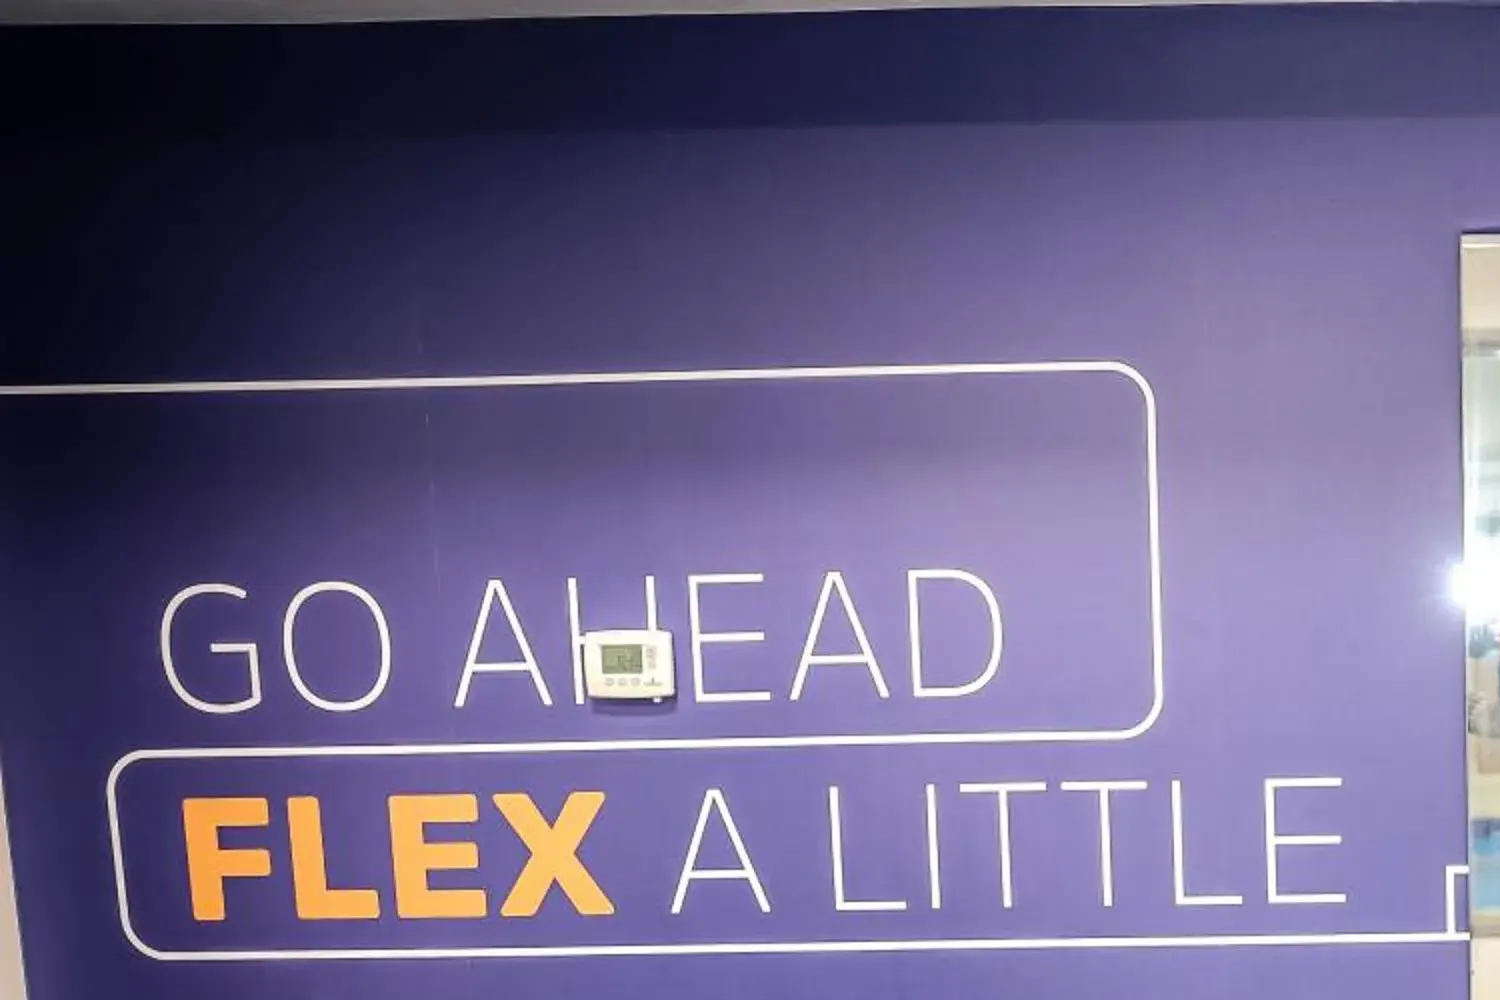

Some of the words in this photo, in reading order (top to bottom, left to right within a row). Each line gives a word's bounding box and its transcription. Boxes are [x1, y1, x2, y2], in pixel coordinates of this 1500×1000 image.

[160, 581, 392, 715] GO
[454, 568, 1004, 709] AHEAD
[182, 791, 616, 922] FLEX
[670, 787, 771, 915] A
[828, 775, 1348, 912] LITTLE
